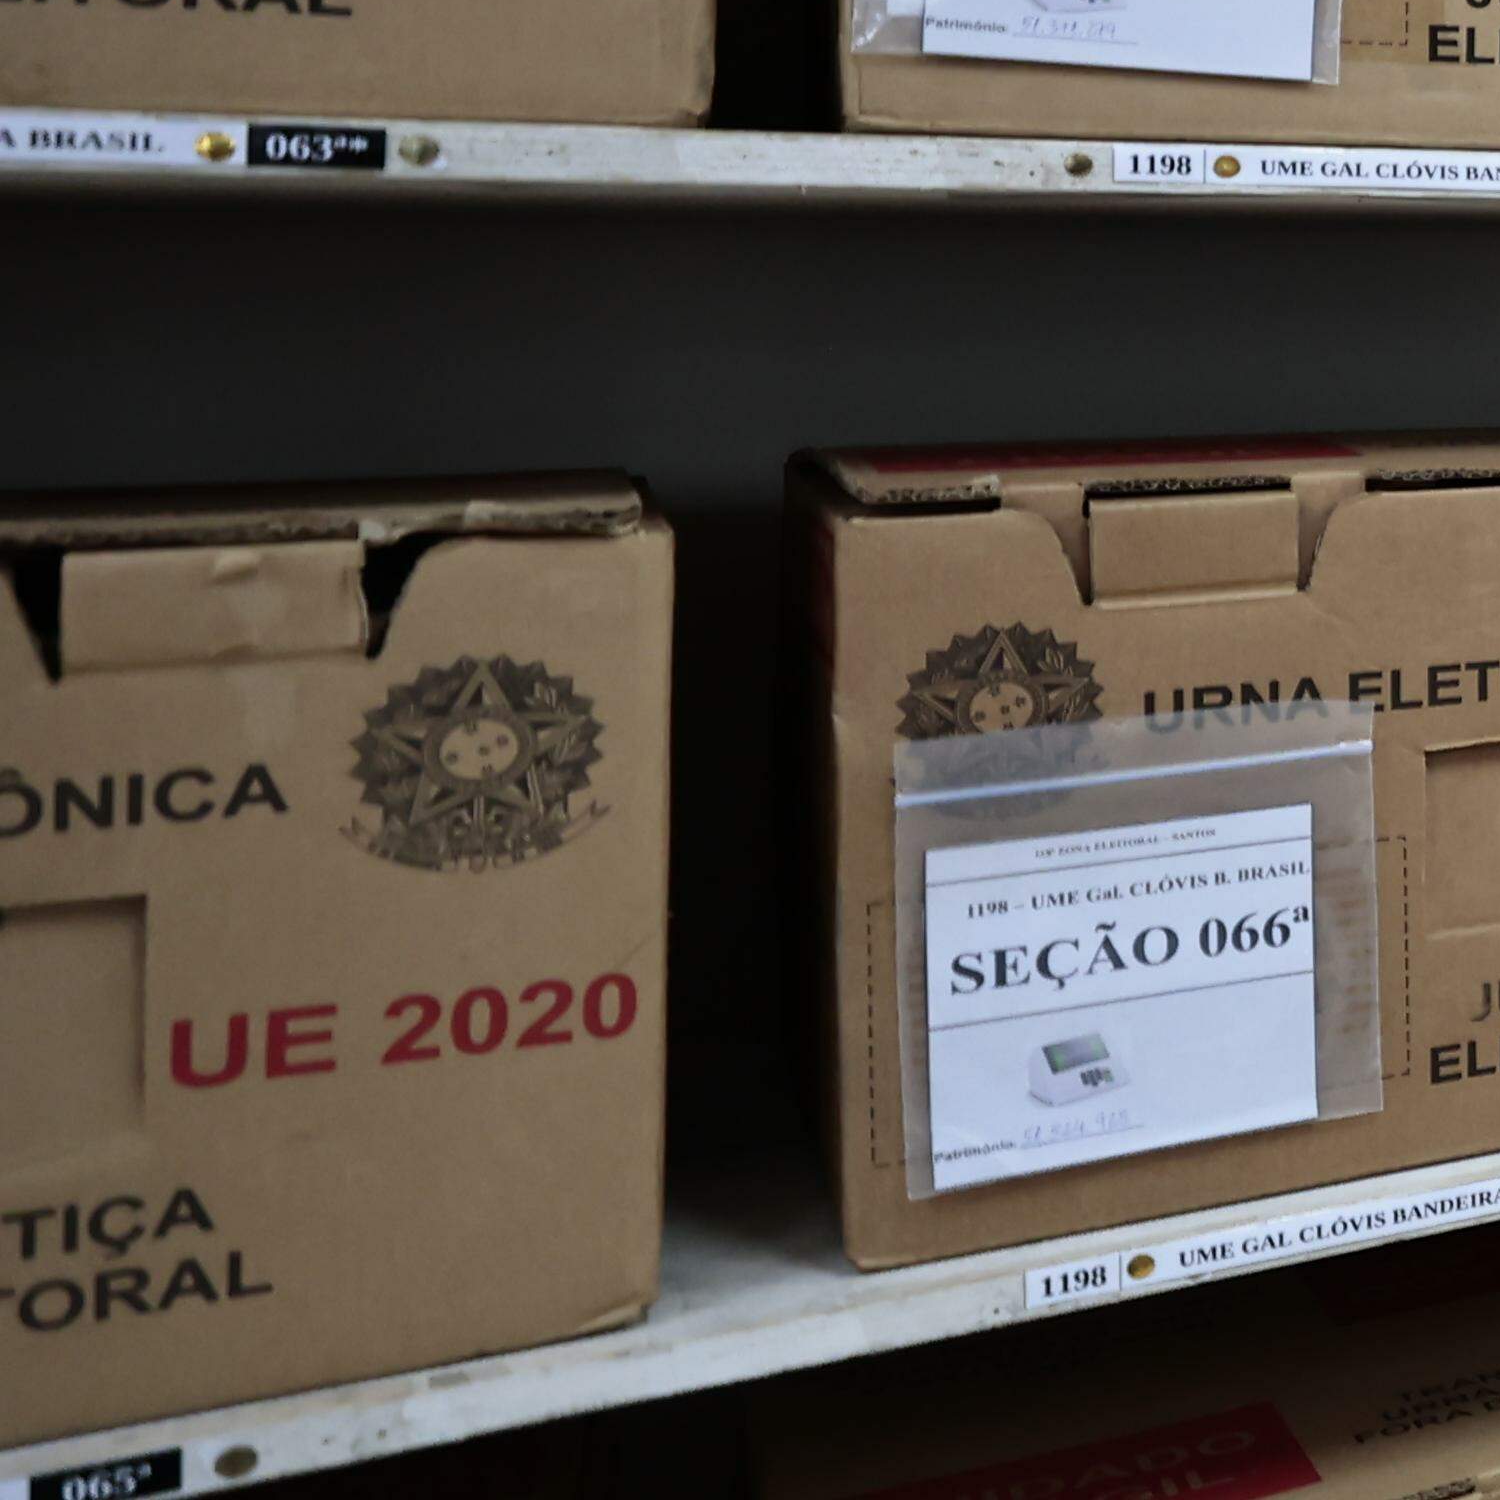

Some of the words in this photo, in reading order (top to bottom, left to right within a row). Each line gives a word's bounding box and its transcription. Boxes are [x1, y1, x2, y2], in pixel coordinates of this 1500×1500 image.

[1127, 153, 1193, 178] 1198
[1261, 159, 1315, 179] UME
[1320, 161, 1371, 181] GAL
[1375, 158, 1460, 184] CLÓVIS
[1143, 674, 1331, 738] URNA
[1031, 890, 1080, 912] UME
[1130, 874, 1209, 899] CLÓVIS
[950, 920, 1180, 997] SEÇÃO
[1199, 903, 1311, 959] 066ª
[170, 1003, 339, 1088] UE
[381, 971, 639, 1066] 2020
[1178, 1238, 1236, 1270] UME
[1240, 1228, 1294, 1258] GAL
[1298, 1210, 1388, 1246] CLÓVIS
[1040, 1265, 1109, 1299] 1198
